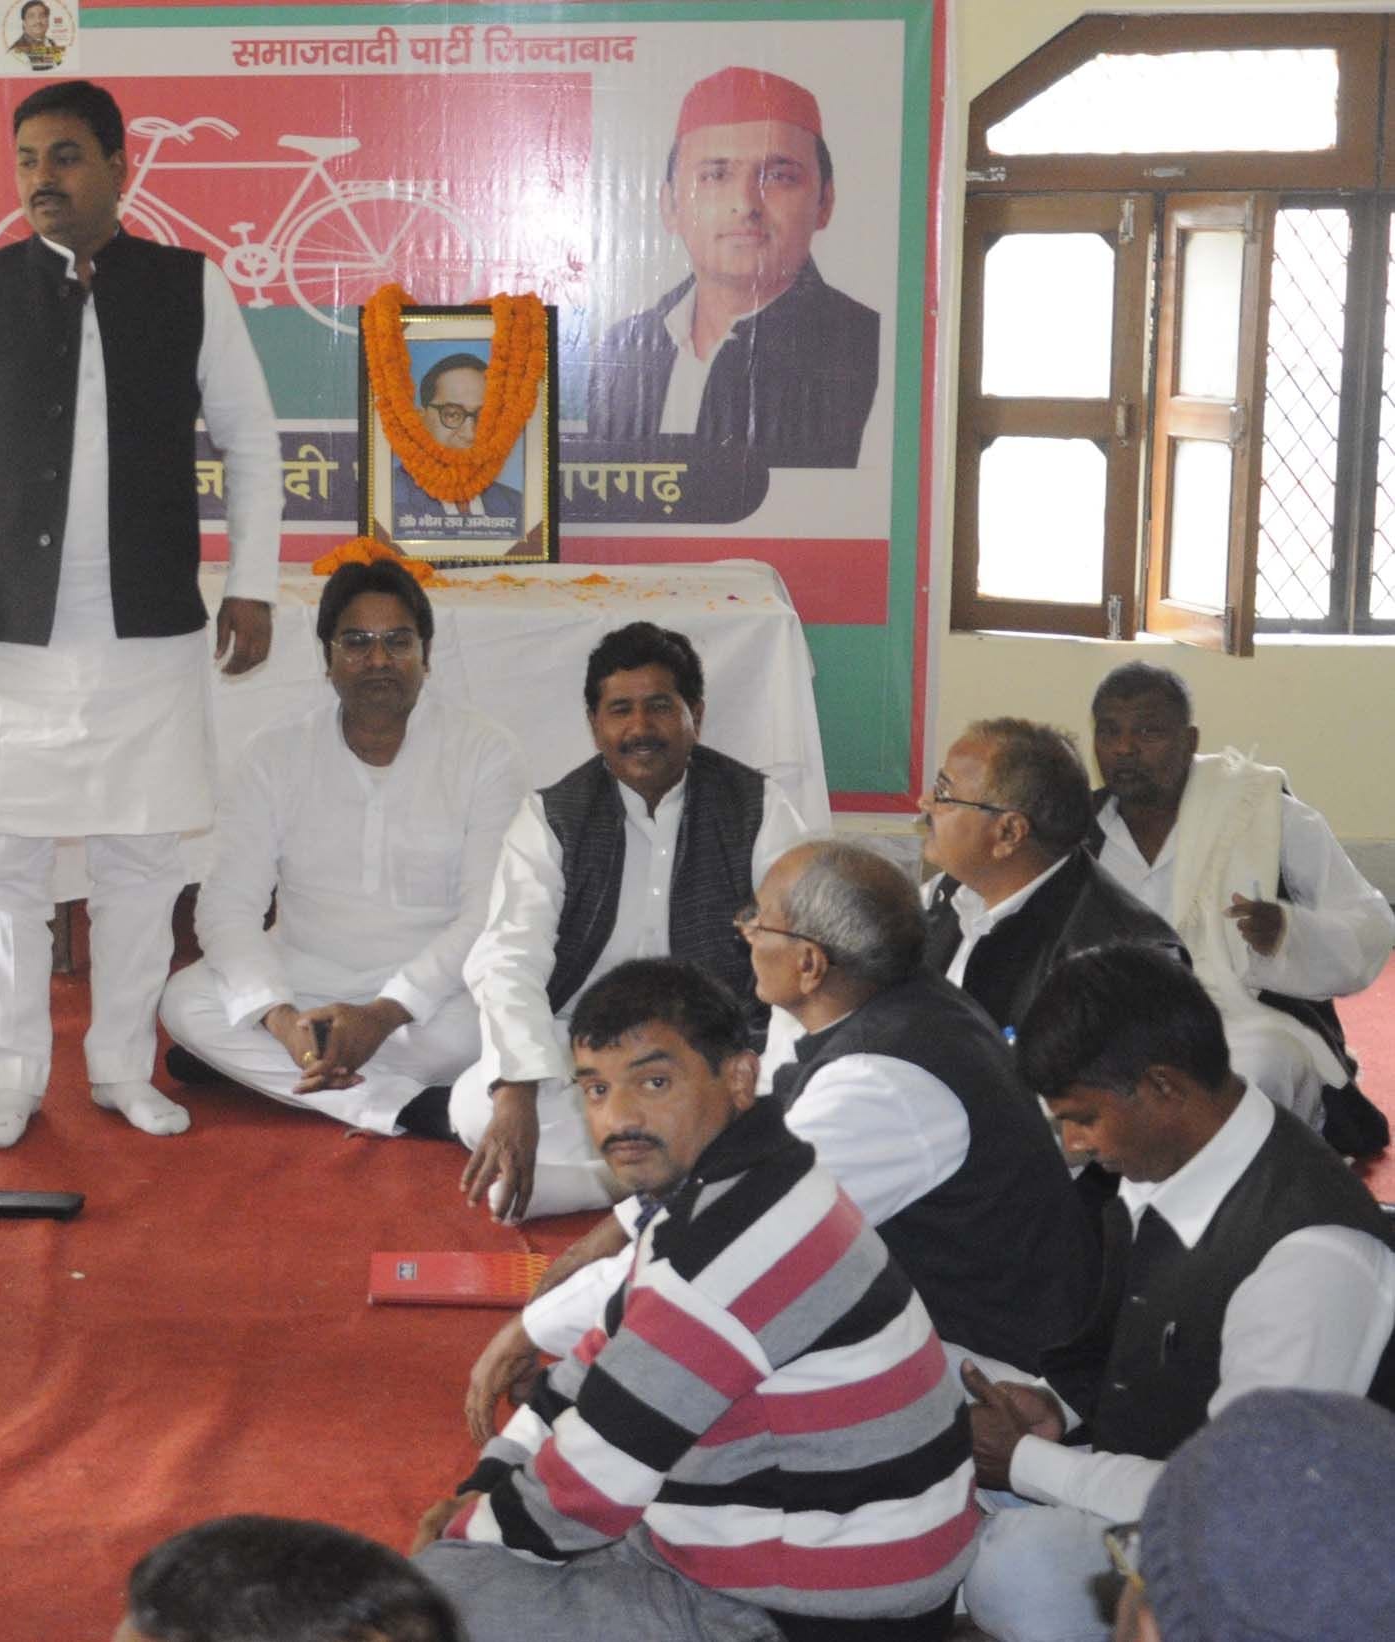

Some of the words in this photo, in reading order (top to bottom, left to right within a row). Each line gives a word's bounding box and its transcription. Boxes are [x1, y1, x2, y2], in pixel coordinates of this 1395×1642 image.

[231, 26, 401, 68] समाजवादी
[409, 25, 474, 66] पार्टी
[483, 24, 638, 65] जिन्दाबाद
